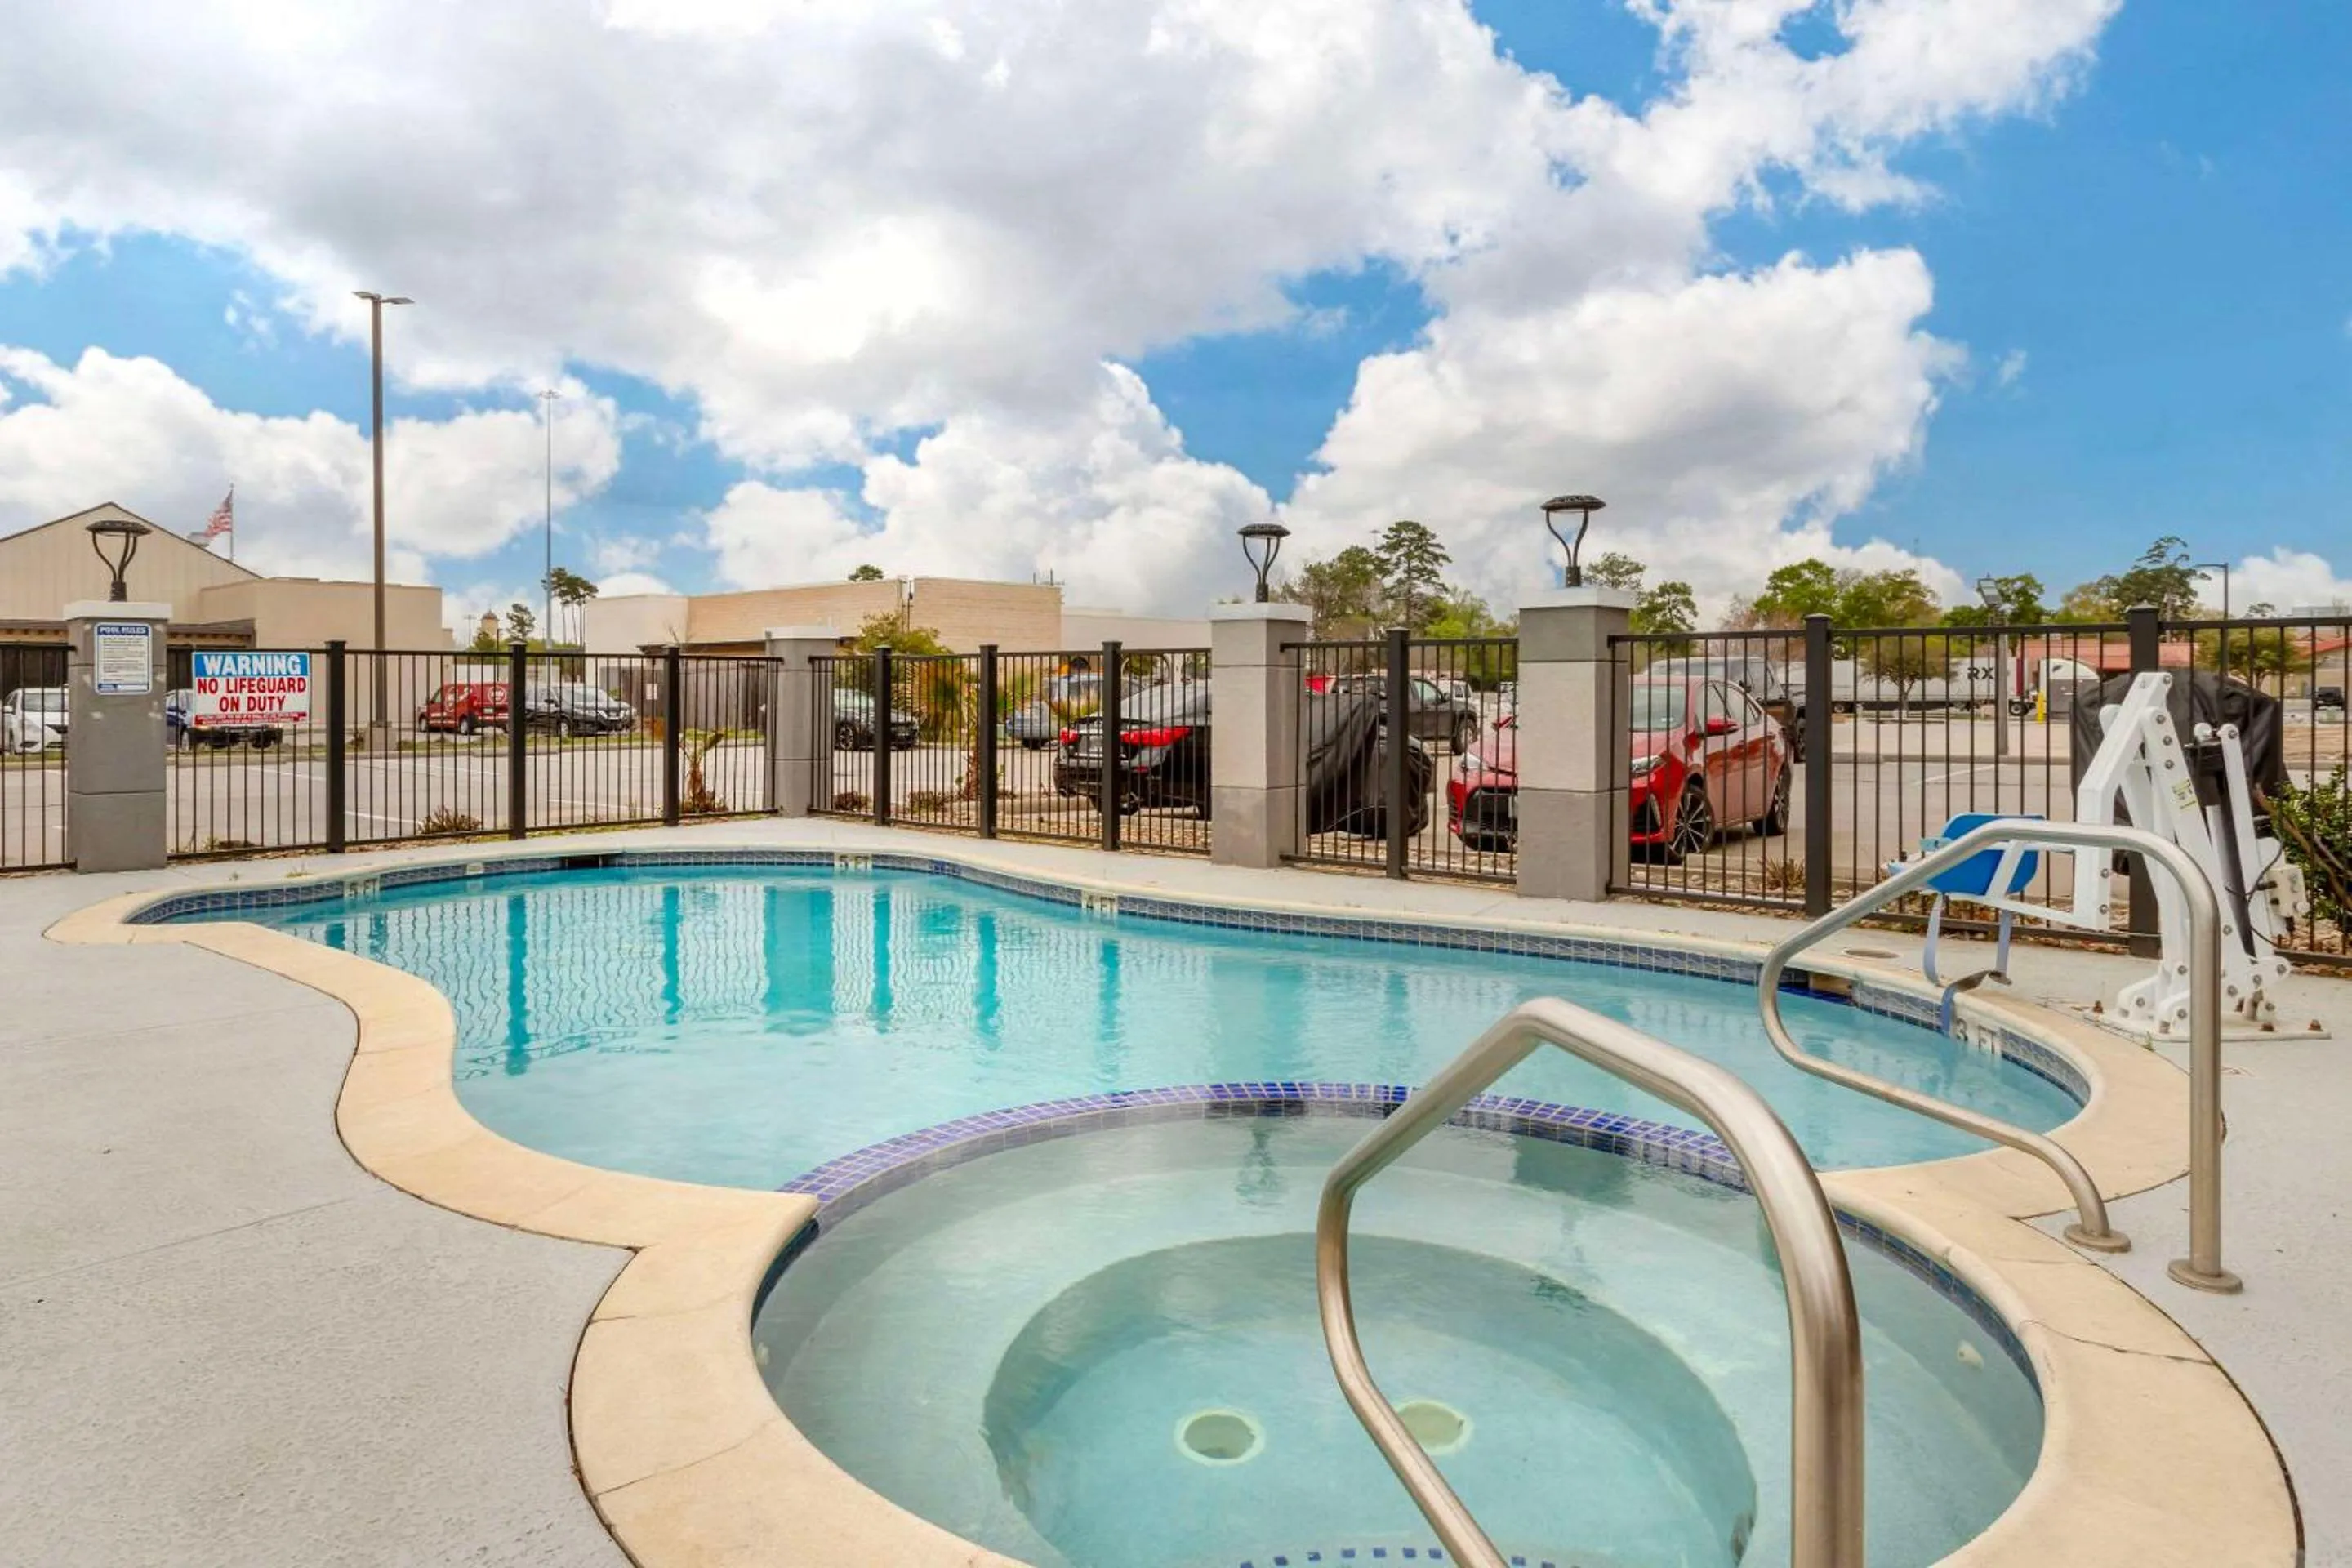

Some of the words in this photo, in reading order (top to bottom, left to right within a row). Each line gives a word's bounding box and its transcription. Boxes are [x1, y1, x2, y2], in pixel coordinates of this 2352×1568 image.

[100, 626, 119, 635] POOL
[203, 654, 301, 675] WARNING
[197, 678, 218, 693] NO
[225, 677, 306, 693] LIFEGUARD
[219, 696, 240, 712] ON
[247, 696, 286, 711] DUTY
[854, 855, 870, 870] FT
[363, 877, 378, 896] FT
[1100, 896, 1116, 912] FT
[1956, 1018, 1968, 1043] 3
[1978, 1025, 1997, 1054] FT
